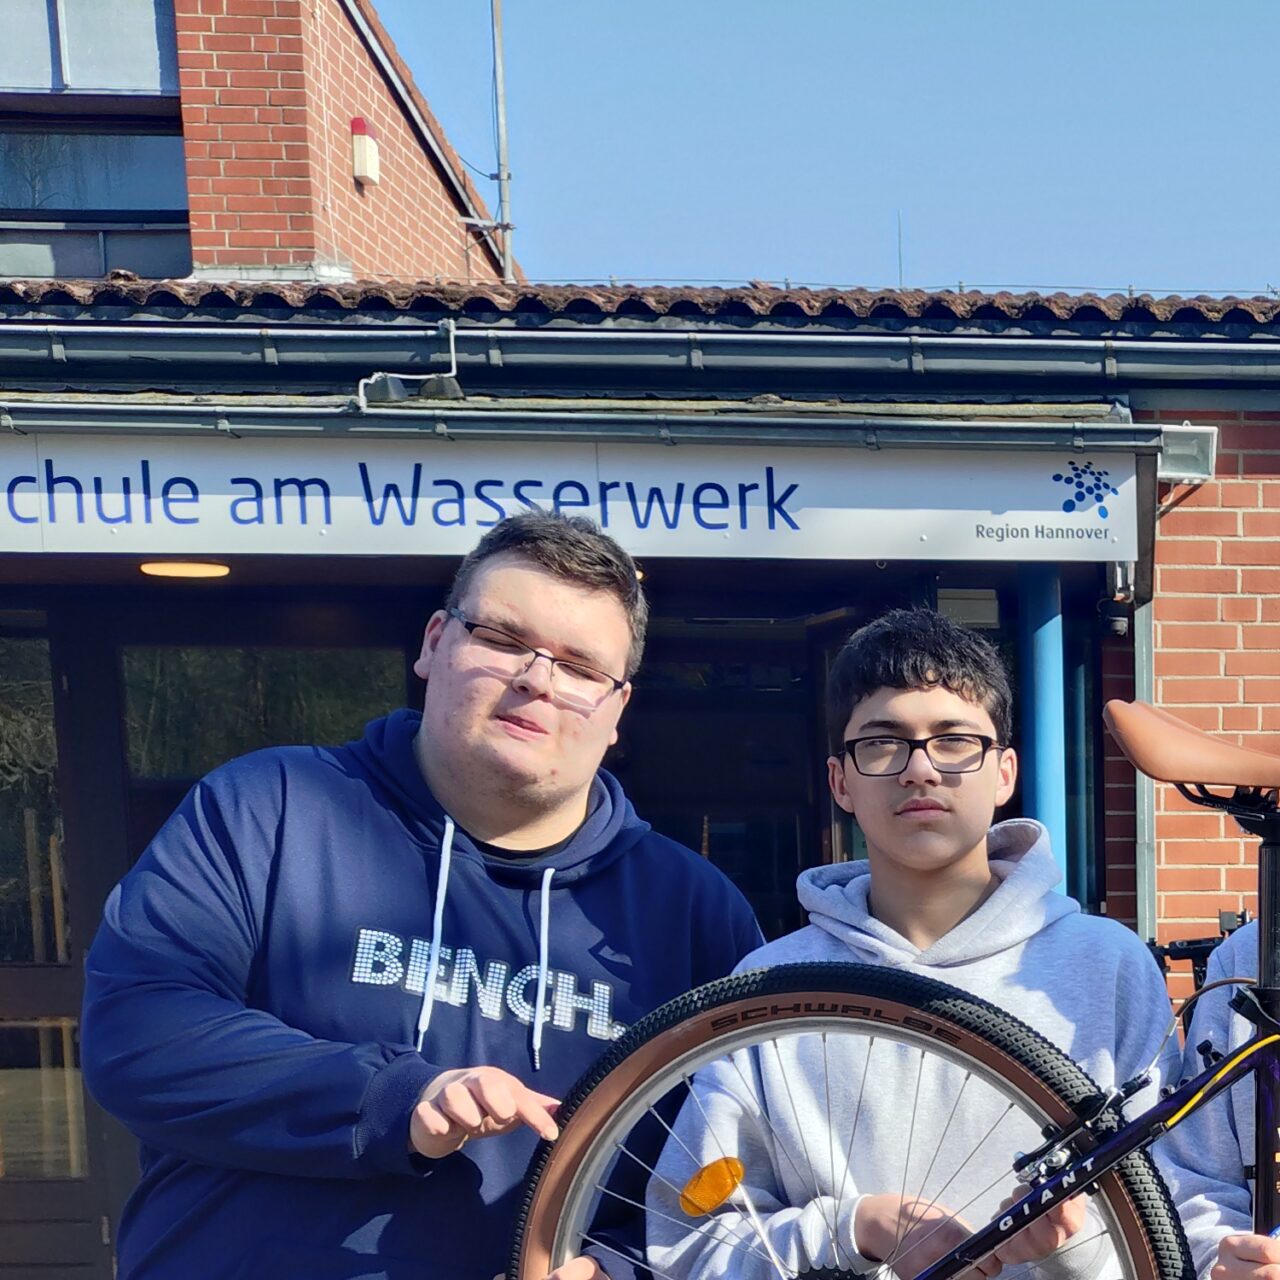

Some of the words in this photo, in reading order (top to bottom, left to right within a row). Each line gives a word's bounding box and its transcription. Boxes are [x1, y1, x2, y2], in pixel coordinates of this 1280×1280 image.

[7, 459, 200, 524] chule
[230, 477, 332, 525] am
[358, 462, 800, 531] Wasserwerk
[975, 523, 1030, 542] Region
[1034, 525, 1109, 540] Hannover
[710, 1003, 962, 1044] SCHWALBE
[998, 1157, 1095, 1232] GIANT
